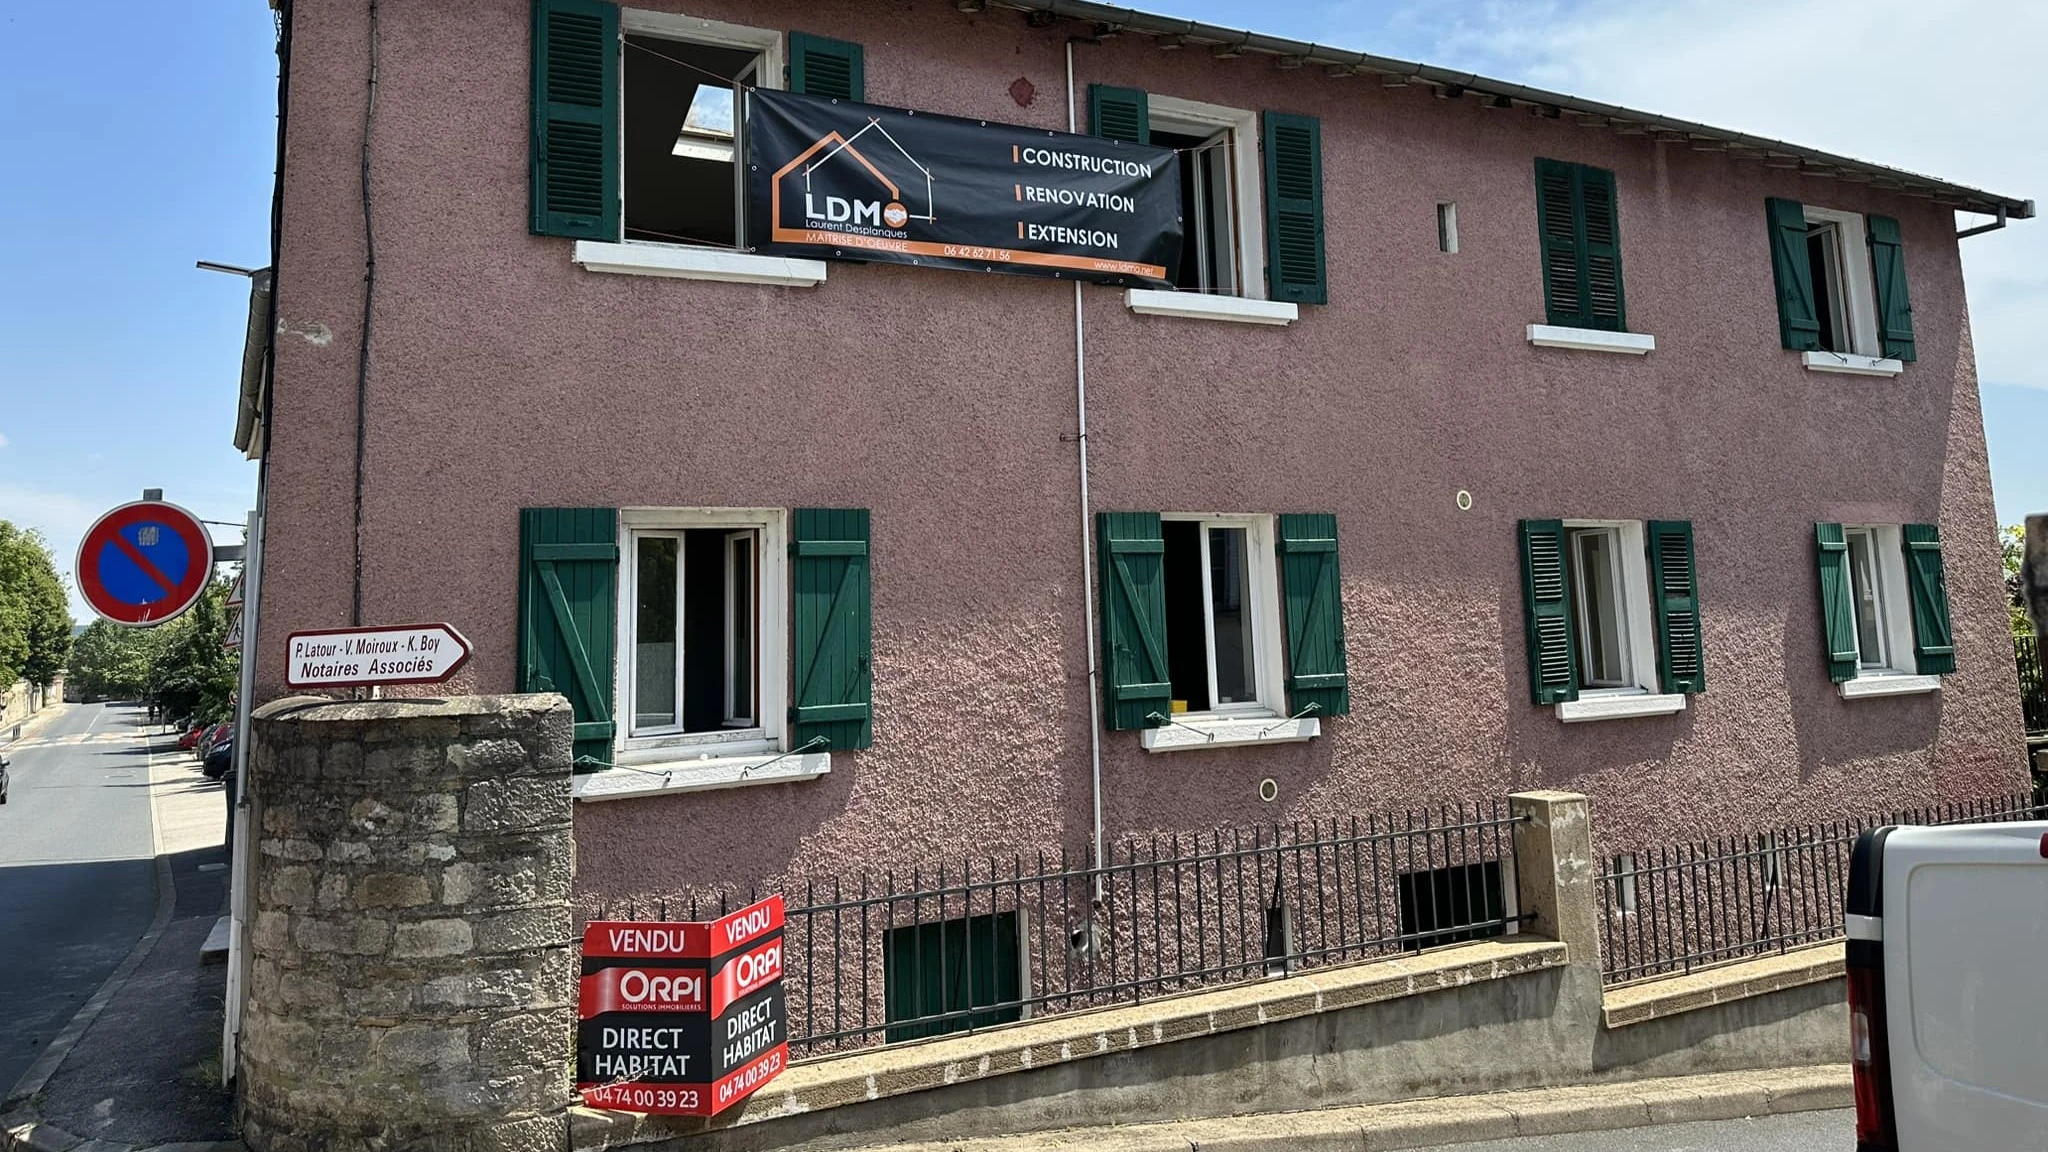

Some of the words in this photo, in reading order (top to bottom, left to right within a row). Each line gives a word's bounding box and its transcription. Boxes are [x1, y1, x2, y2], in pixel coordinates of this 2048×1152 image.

[1022, 148, 1152, 179] CONSTRUCTION
[1025, 186, 1135, 213] RENOVATION
[805, 219, 843, 232] Laurent
[845, 224, 908, 239] Desplanques
[1028, 223, 1118, 249] EXTENSION
[944, 245, 956, 256] 06
[958, 247, 970, 257] 42
[973, 248, 984, 258] 62
[986, 249, 996, 259] 71
[999, 250, 1010, 261] 56
[295, 643, 303, 658] P.
[305, 641, 337, 658] Latour
[345, 640, 353, 656] V.
[356, 637, 398, 655] Moiroux
[407, 636, 418, 652] K.
[420, 635, 441, 654] Boy
[301, 661, 359, 678] Notaires
[368, 656, 433, 675] Associés
[725, 906, 771, 944] VENDU
[608, 929, 685, 953] VENDU
[736, 944, 780, 987] ORPI
[620, 970, 701, 1003] ORPI
[727, 997, 772, 1039] DIRECT
[602, 1027, 683, 1049] DIRECT
[723, 1020, 777, 1069] HABITAT
[595, 1054, 691, 1076] HABITAT
[720, 1080, 733, 1103] 04
[733, 1073, 745, 1095] 74
[745, 1066, 758, 1087] 00
[758, 1059, 769, 1080] 39
[770, 1051, 781, 1073] 23
[593, 1087, 613, 1103] 04
[614, 1088, 632, 1105] 74
[634, 1089, 654, 1107] 00
[656, 1090, 677, 1108] 39
[679, 1090, 699, 1108] 23
